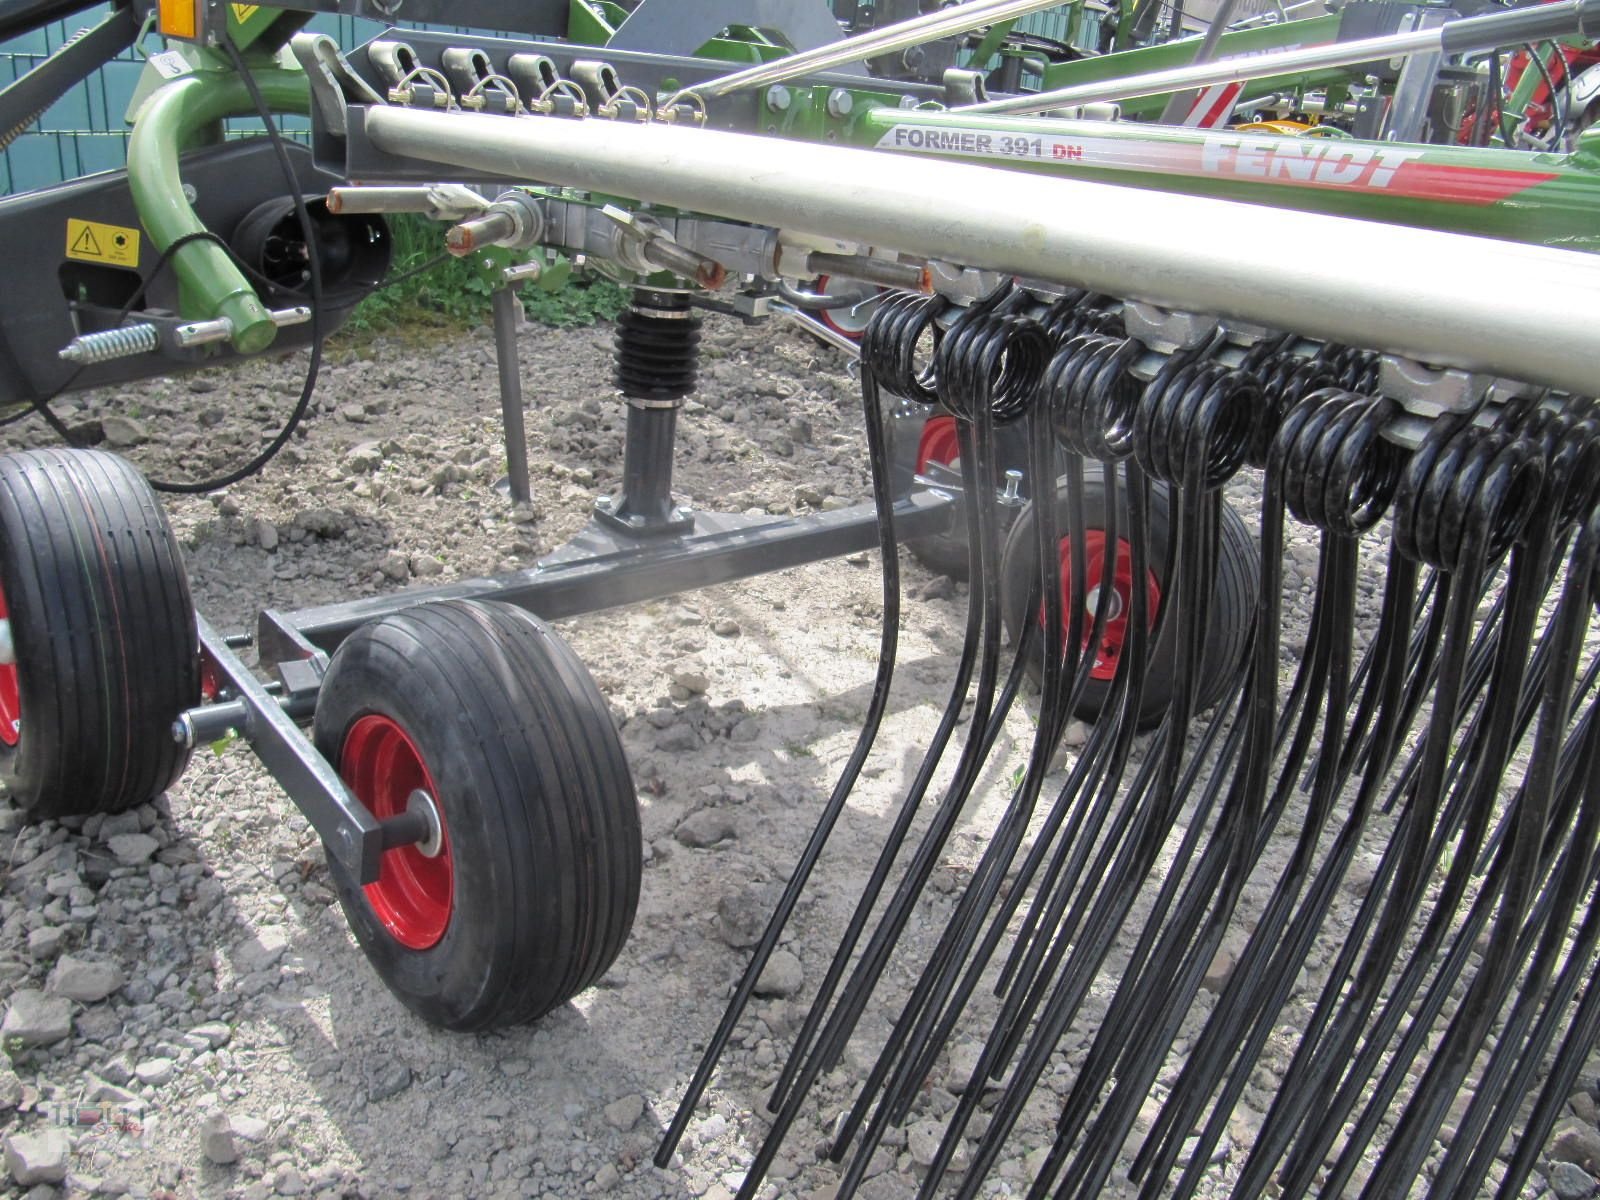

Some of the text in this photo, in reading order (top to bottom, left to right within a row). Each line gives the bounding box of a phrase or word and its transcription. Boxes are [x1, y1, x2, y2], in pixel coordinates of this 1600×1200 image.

[895, 128, 1082, 160] FORMER 391 DN
[1201, 136, 1424, 188] FENDT
